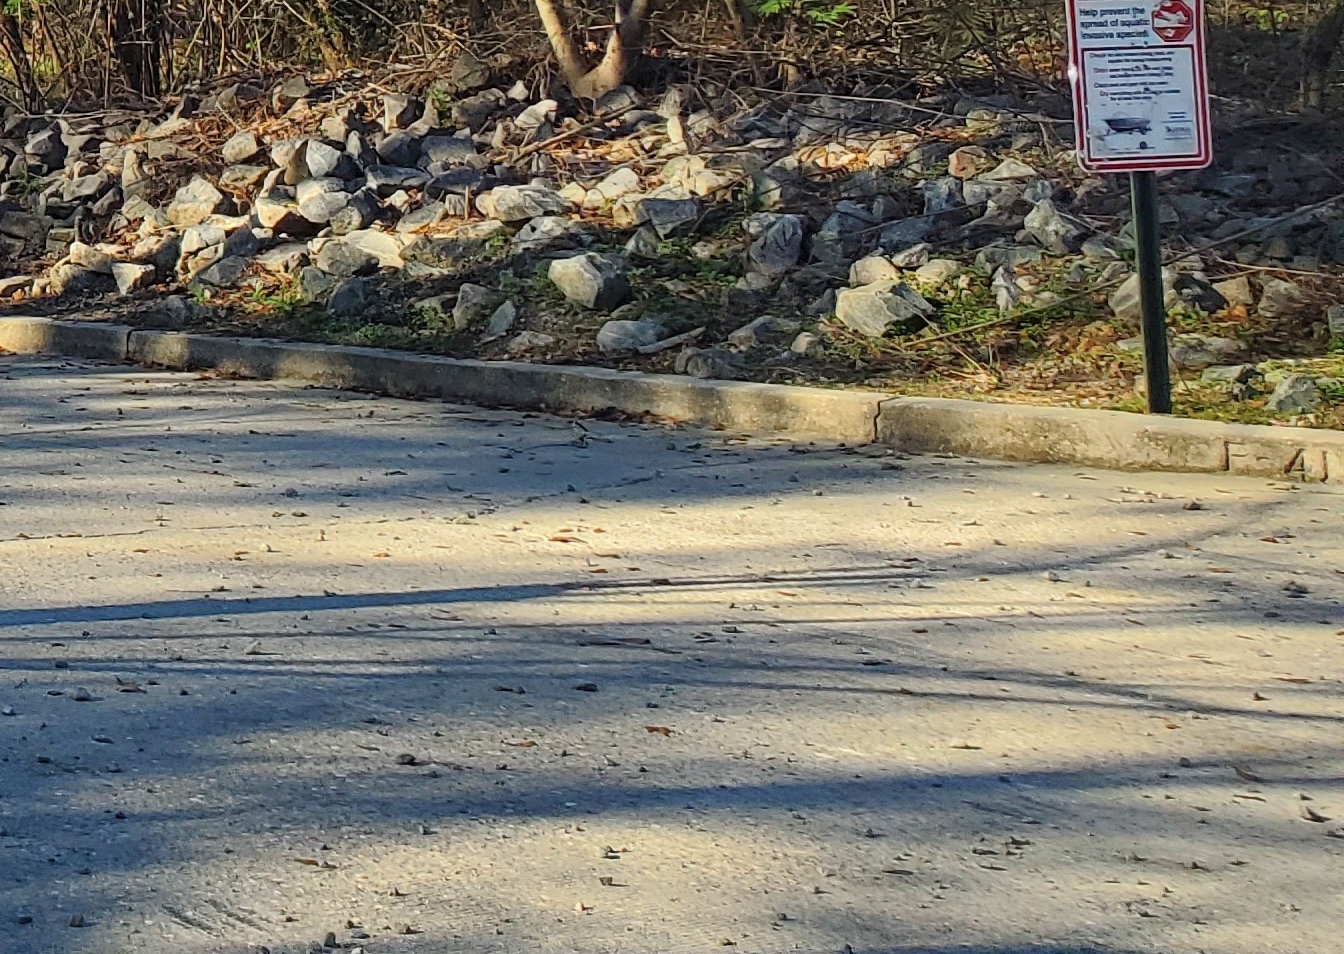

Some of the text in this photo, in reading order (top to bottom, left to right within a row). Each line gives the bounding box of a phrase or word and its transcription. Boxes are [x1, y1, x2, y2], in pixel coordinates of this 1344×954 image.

[1079, 7, 1145, 17] Help prevent the
[1080, 20, 1109, 29] spread
[1120, 18, 1150, 28] aquatic
[1081, 31, 1114, 39] invasive
